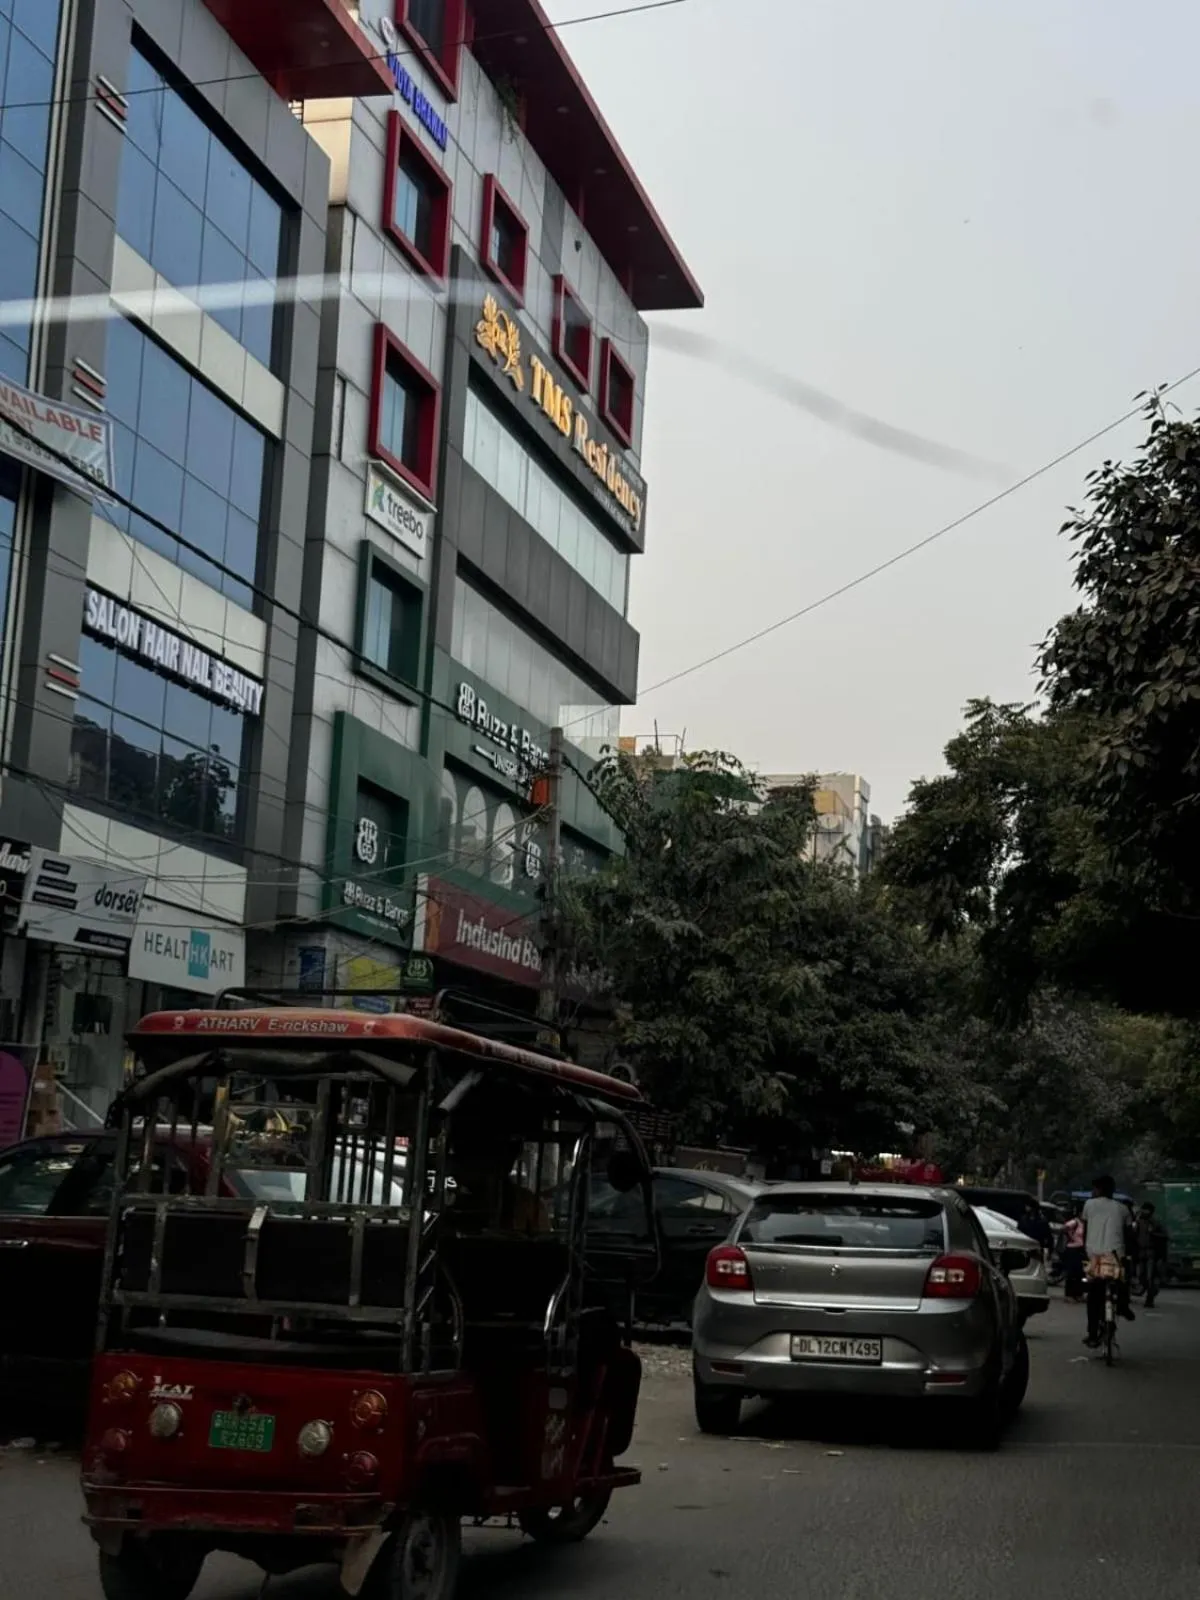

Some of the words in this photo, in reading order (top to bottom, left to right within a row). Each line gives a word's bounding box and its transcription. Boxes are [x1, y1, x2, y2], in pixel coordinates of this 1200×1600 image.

[530, 354, 572, 438] TMS
[572, 411, 643, 530] Residency
[387, 493, 424, 540] treebo
[85, 590, 140, 650] SALON
[140, 621, 180, 674] HAIR
[180, 645, 211, 689] NAIL
[211, 660, 264, 716] BEAUTY
[144, 930, 234, 972] HEALTHKART
[456, 908, 522, 964] IndusInd
[197, 1016, 261, 1031] ATHARV
[267, 1018, 350, 1033] E-rickshaw
[799, 1341, 879, 1357] DL12CN1495
